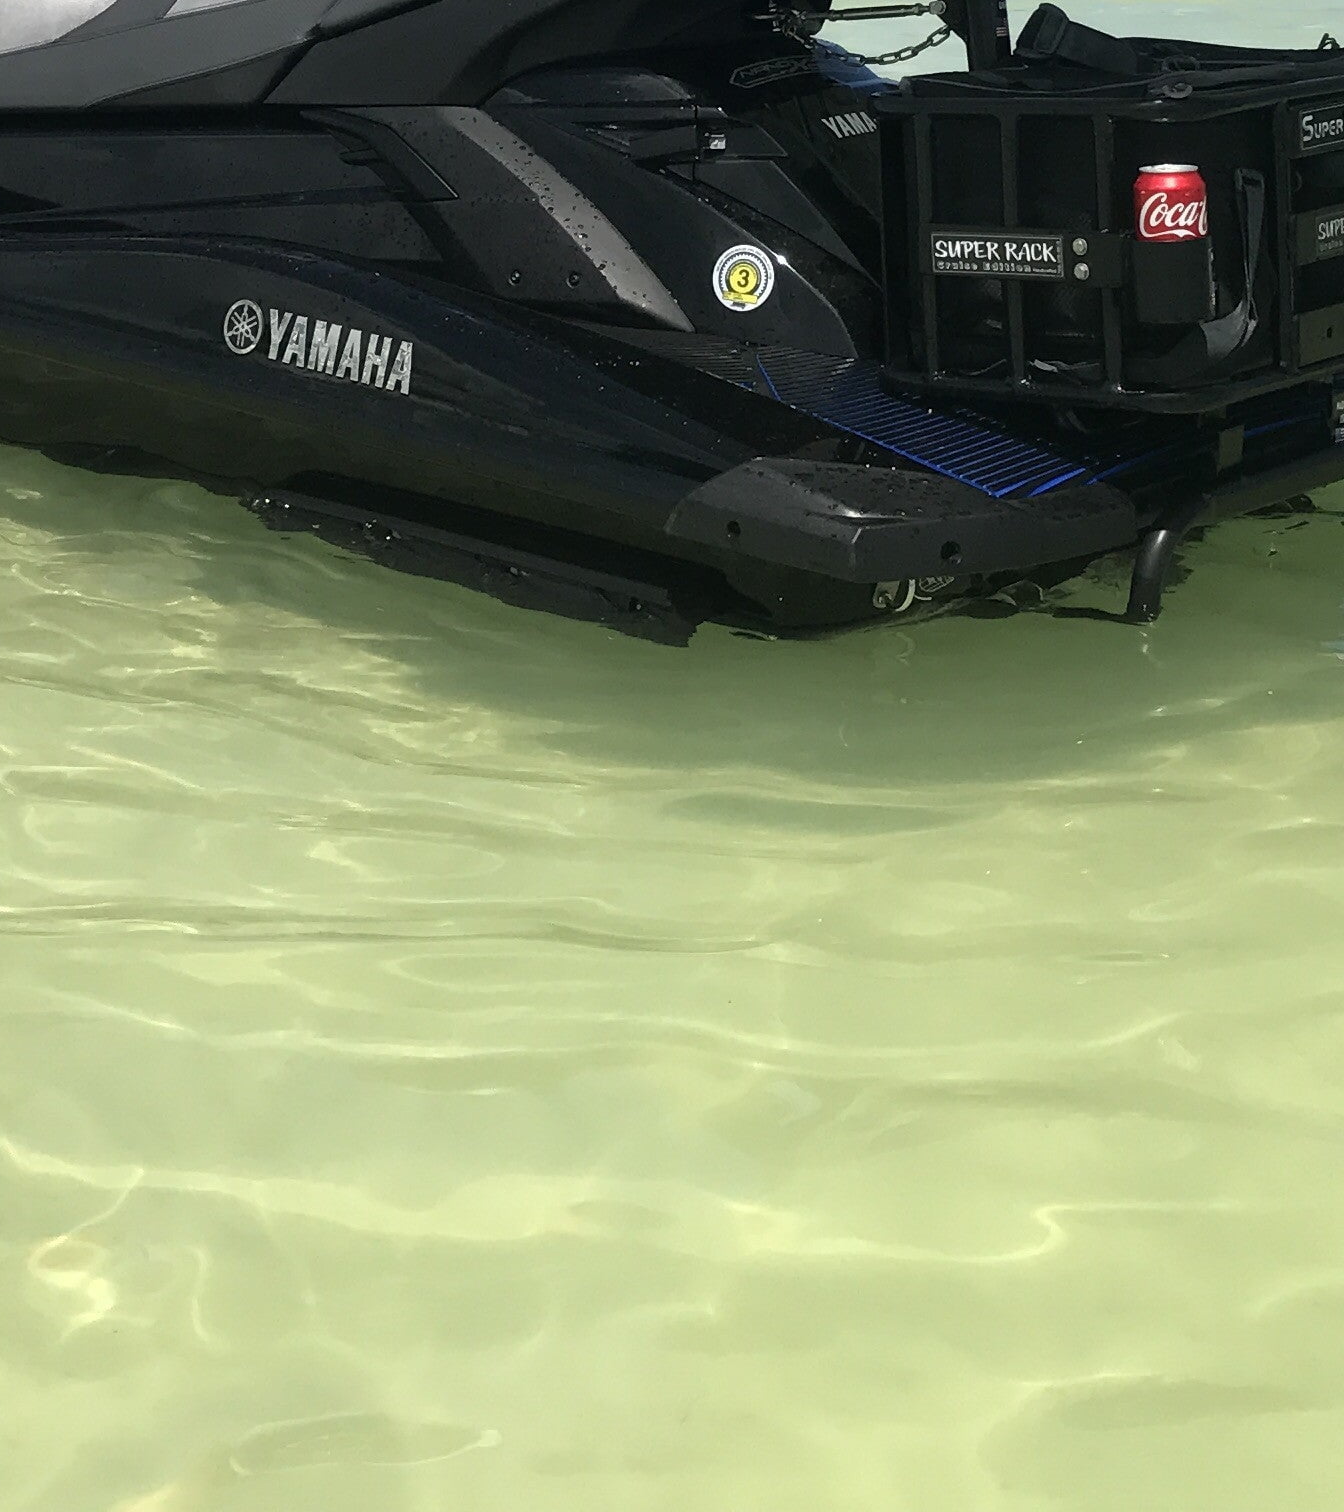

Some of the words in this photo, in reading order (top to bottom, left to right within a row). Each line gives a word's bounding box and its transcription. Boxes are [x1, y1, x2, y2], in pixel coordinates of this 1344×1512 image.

[820, 111, 877, 138] YAMA
[934, 240, 1001, 261] SUPER
[1005, 241, 1057, 263] RACK
[737, 269, 750, 288] 3
[267, 308, 414, 395] YAMAHA
